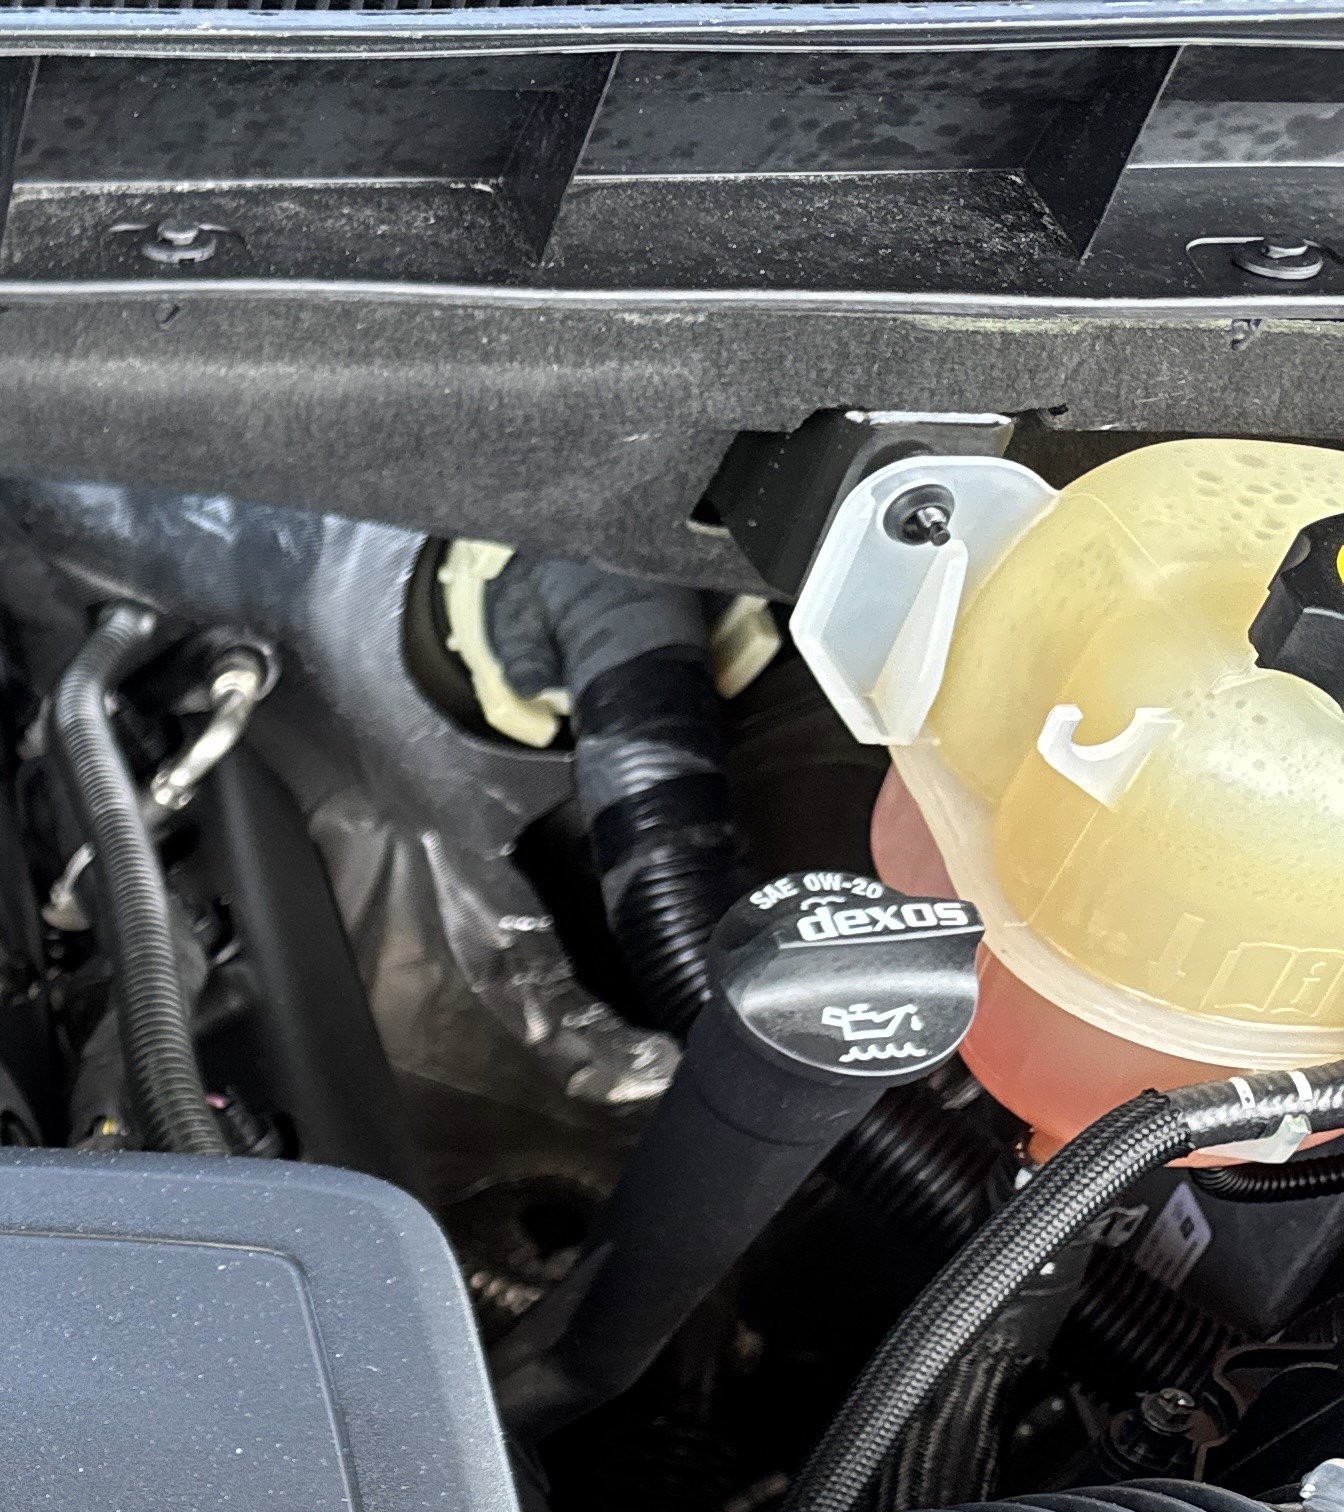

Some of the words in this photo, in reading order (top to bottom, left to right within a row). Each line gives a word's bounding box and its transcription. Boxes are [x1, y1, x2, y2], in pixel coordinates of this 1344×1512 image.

[749, 877, 800, 910] SAE
[802, 871, 885, 899] 0W-20
[796, 902, 969, 942] dexos
